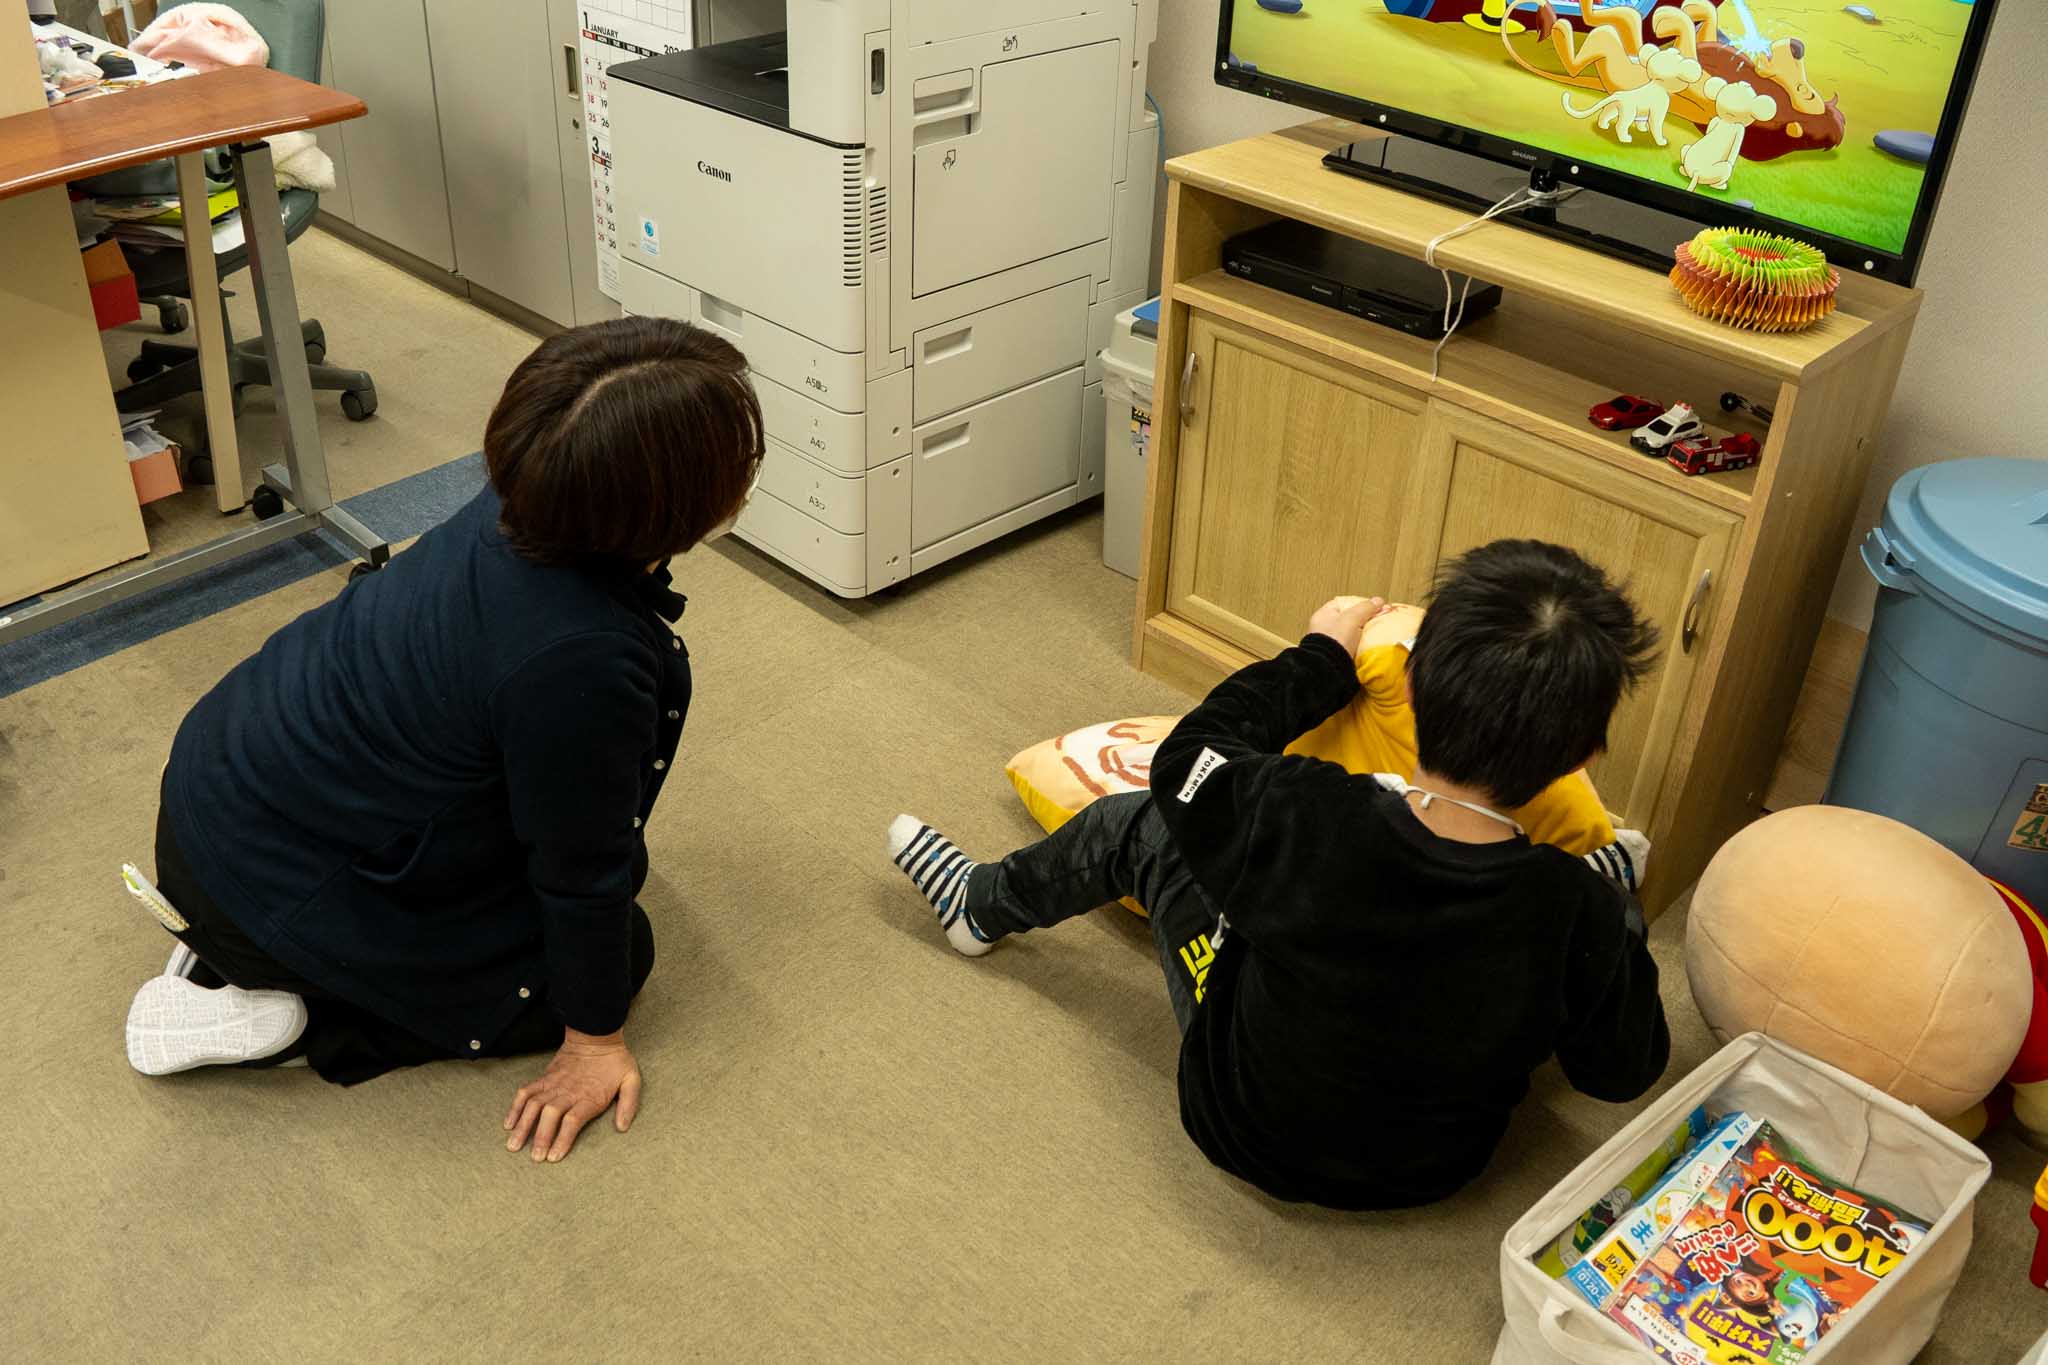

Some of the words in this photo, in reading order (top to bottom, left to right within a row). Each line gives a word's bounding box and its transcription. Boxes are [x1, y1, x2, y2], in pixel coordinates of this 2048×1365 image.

[583, 11, 589, 30] 1
[590, 24, 618, 38] JANUARY
[600, 80, 607, 90] 12
[601, 98, 608, 108] 19
[601, 118, 610, 128] 26
[592, 136, 600, 154] 3
[604, 167, 609, 176] 2
[697, 160, 732, 183] Canon
[1746, 1191, 1905, 1278] 4000
